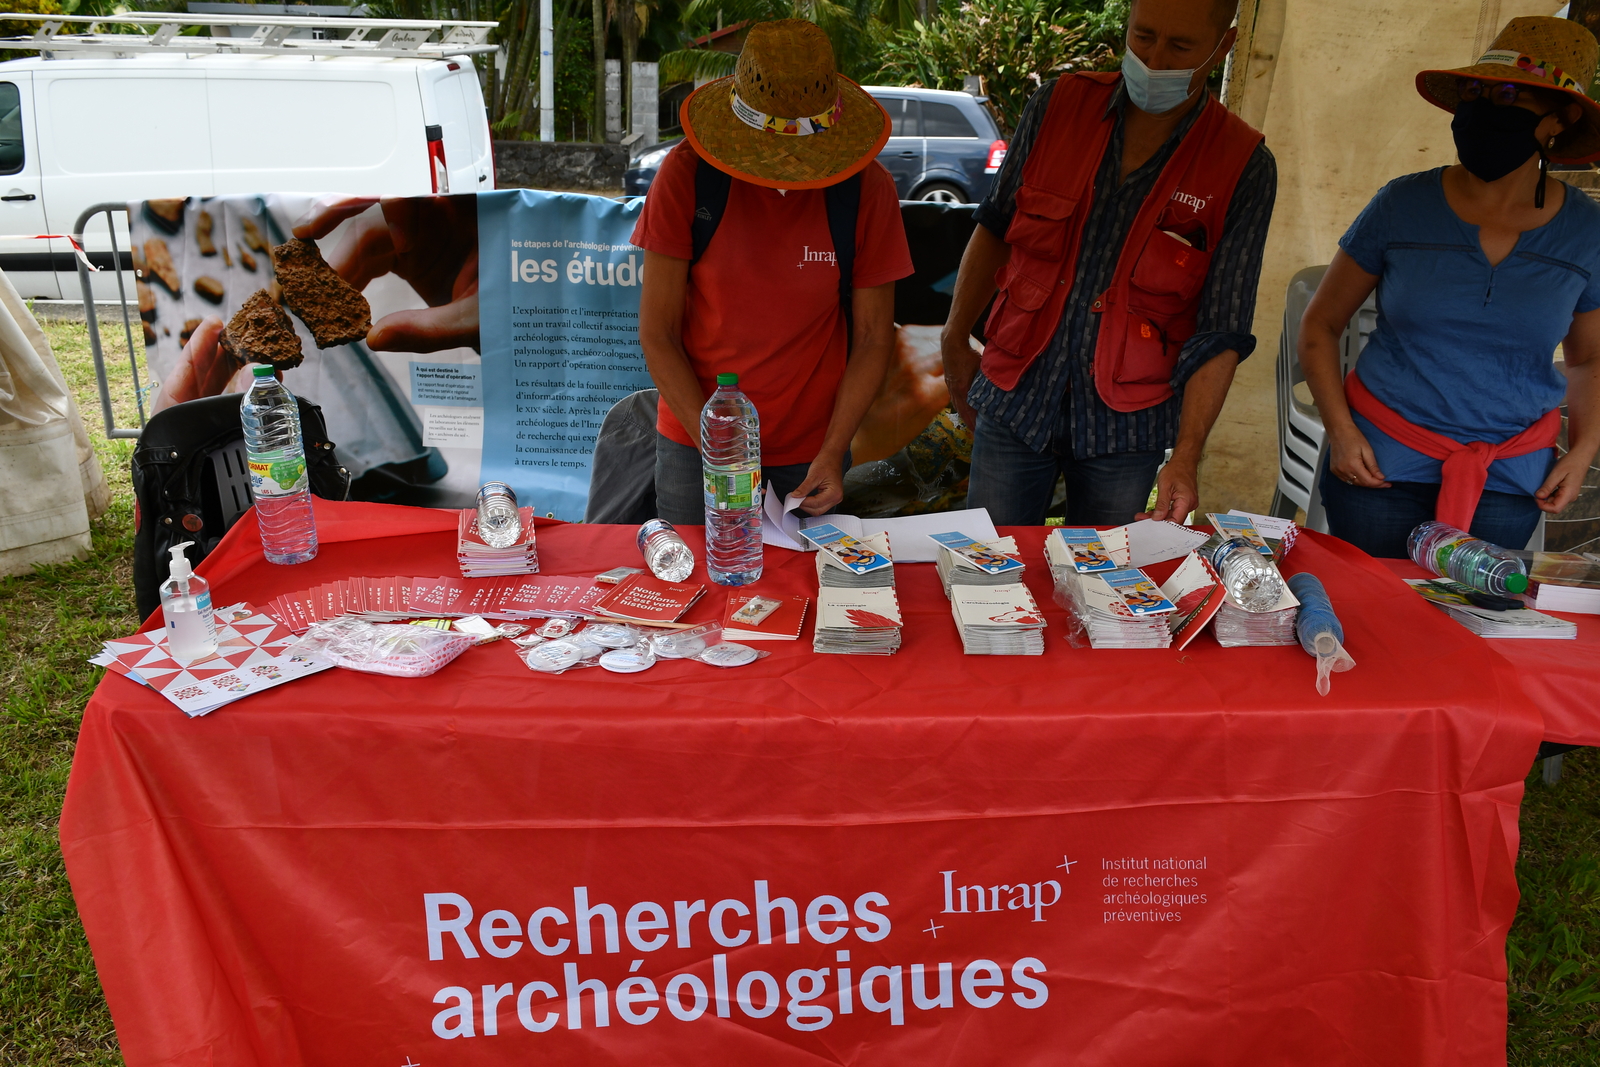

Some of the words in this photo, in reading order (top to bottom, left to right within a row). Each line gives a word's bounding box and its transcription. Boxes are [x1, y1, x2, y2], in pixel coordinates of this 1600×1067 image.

[511, 239, 523, 248] les
[523, 240, 551, 250] étapes
[552, 240, 563, 248] de
[564, 240, 610, 252] l'archéologie
[511, 250, 559, 283] les
[512, 305, 570, 317] L'exploitation
[579, 307, 639, 319] l'interprétation
[512, 320, 531, 328] sont
[545, 320, 571, 328] travail
[572, 320, 603, 331] collectif
[513, 333, 570, 343] archéologues,
[570, 334, 627, 346] céramologues,
[513, 346, 570, 356] palynologues,
[571, 347, 639, 360] archéozoologues,
[514, 360, 527, 368] Un
[528, 360, 560, 370] rapport
[561, 359, 607, 371] d'opération
[607, 364, 643, 372] conserve
[515, 379, 530, 387] Les
[531, 379, 566, 388] résultats
[566, 380, 576, 388] de
[577, 380, 585, 389] la
[586, 380, 612, 390] fouille
[516, 391, 575, 401] d'informations
[516, 404, 524, 412] le
[542, 405, 567, 414] siècle.
[568, 406, 592, 416] Après
[592, 407, 600, 415] la
[516, 419, 569, 429] archéologues
[570, 420, 580, 428] de
[516, 431, 526, 439] de
[527, 431, 566, 441] recherche
[567, 432, 581, 443] qui
[582, 434, 599, 444] exp
[515, 444, 523, 453] la
[524, 446, 578, 454] connaissance
[579, 446, 593, 455] des
[514, 458, 520, 466] à
[551, 459, 559, 467] le
[560, 460, 587, 469] temps.
[629, 591, 678, 604] fouillons,
[633, 586, 662, 597] Nous
[620, 599, 663, 612] histoire
[624, 596, 651, 605] c'est
[651, 600, 682, 608] votre
[1102, 857, 1149, 870] Institut
[1153, 856, 1207, 870] national
[1102, 874, 1119, 887] de
[1123, 874, 1198, 887] recherches
[939, 869, 1062, 923] Inrap
[1103, 891, 1207, 907] archéologiques
[423, 880, 892, 961] Recherches
[1103, 908, 1182, 924] préventives
[431, 949, 1050, 1040] archéologiques
